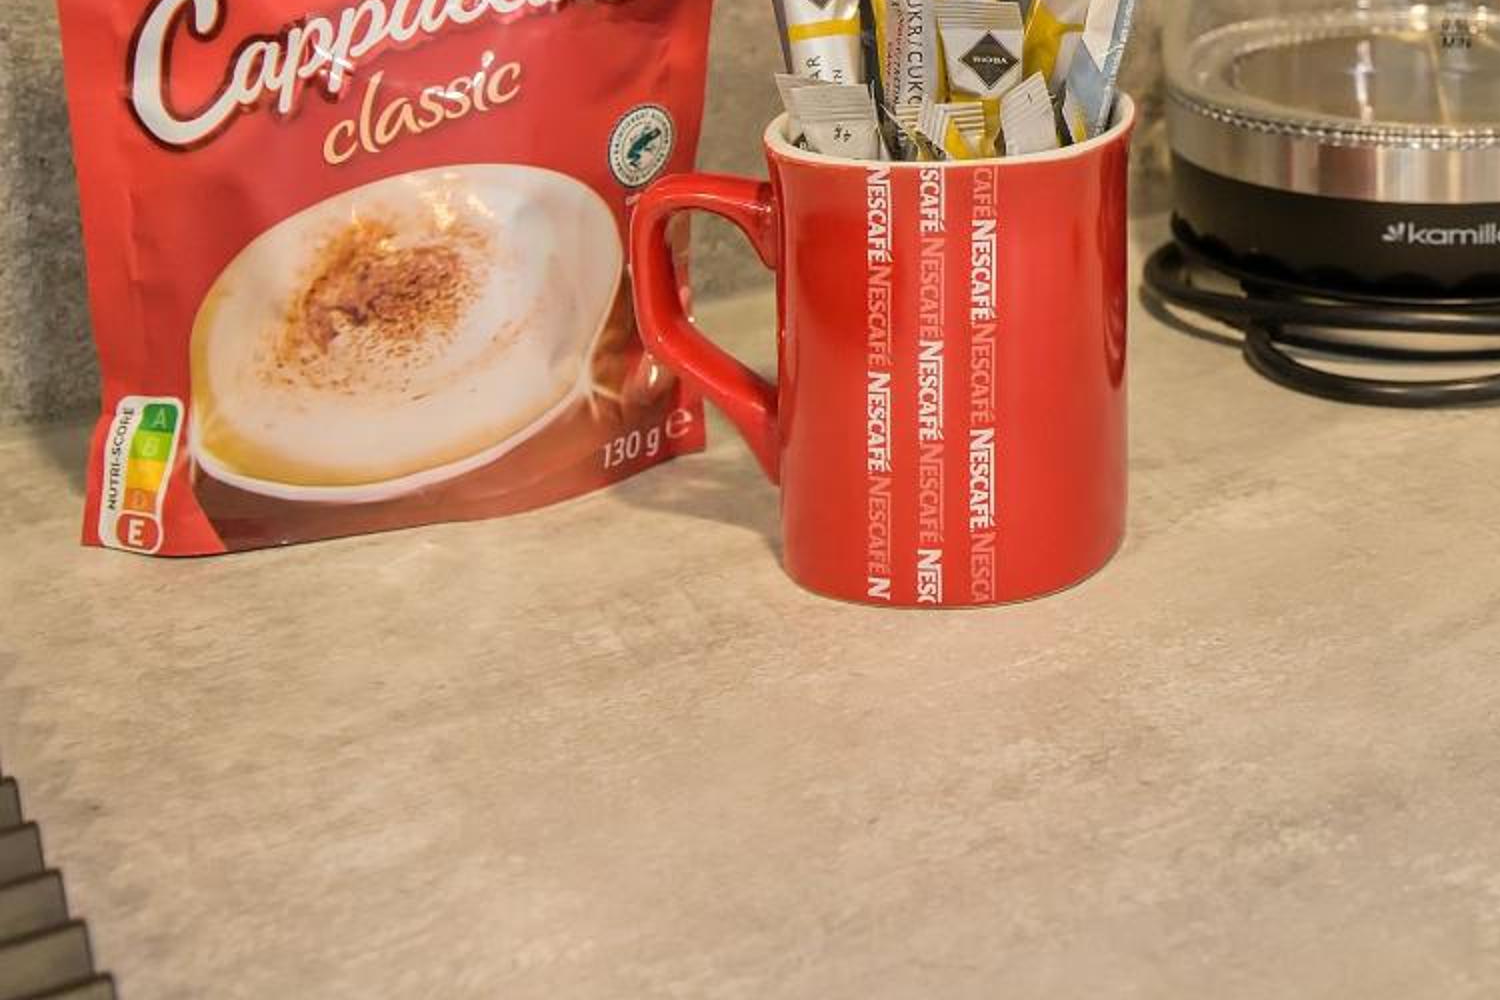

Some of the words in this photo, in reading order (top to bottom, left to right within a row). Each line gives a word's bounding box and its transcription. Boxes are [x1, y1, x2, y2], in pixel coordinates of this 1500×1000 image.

[322, 51, 521, 164] classic
[866, 165, 893, 263] NESCAFÉ
[867, 265, 892, 366] NESCAFÉ
[919, 238, 945, 339] NESCAFÉ
[970, 220, 997, 321] NESCAFÉ
[867, 371, 893, 473] NESCAFÉ
[918, 339, 945, 441] NESCAFÉ
[970, 322, 997, 425] NESCAFÉ
[107, 407, 136, 510] NUTRI-SCORE
[603, 430, 641, 470] 130
[645, 426, 660, 458] g
[919, 443, 945, 543] NESCAFÉ
[969, 428, 997, 530] NESCAFÉ
[127, 518, 146, 547] E
[867, 475, 892, 573] NESCAFÉ
